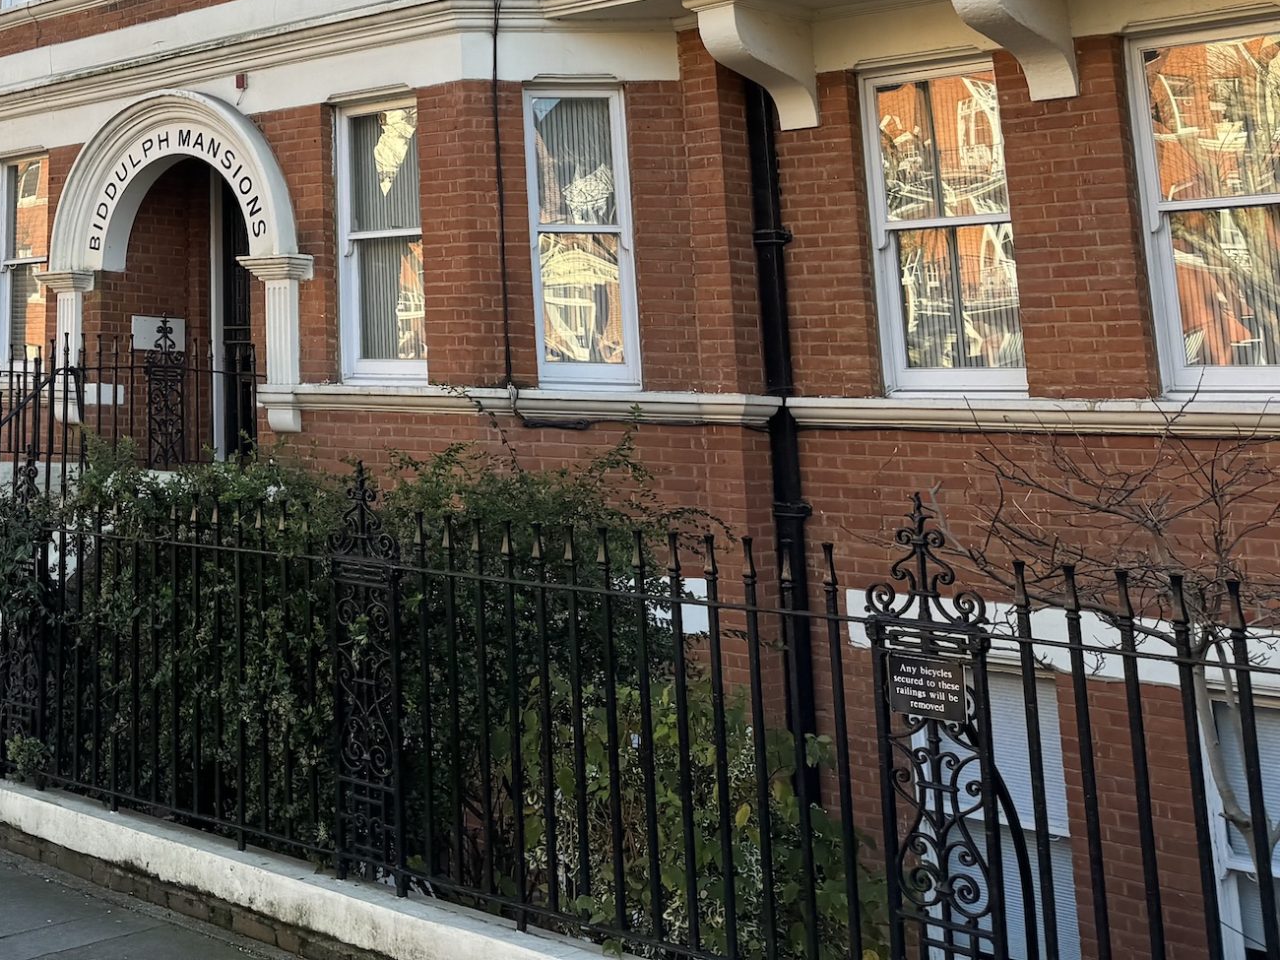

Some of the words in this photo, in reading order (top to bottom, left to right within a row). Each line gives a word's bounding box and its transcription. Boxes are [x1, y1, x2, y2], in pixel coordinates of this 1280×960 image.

[89, 131, 170, 251] BIDDULPH
[177, 129, 267, 238] MANSIONS
[900, 663, 917, 675] Any
[920, 666, 953, 679] bicycles
[893, 675, 924, 686] secured
[926, 680, 936, 688] to
[938, 680, 960, 691] these
[896, 685, 927, 699] railings
[929, 691, 946, 701] will
[948, 692, 959, 703] be
[910, 700, 945, 712] removed
